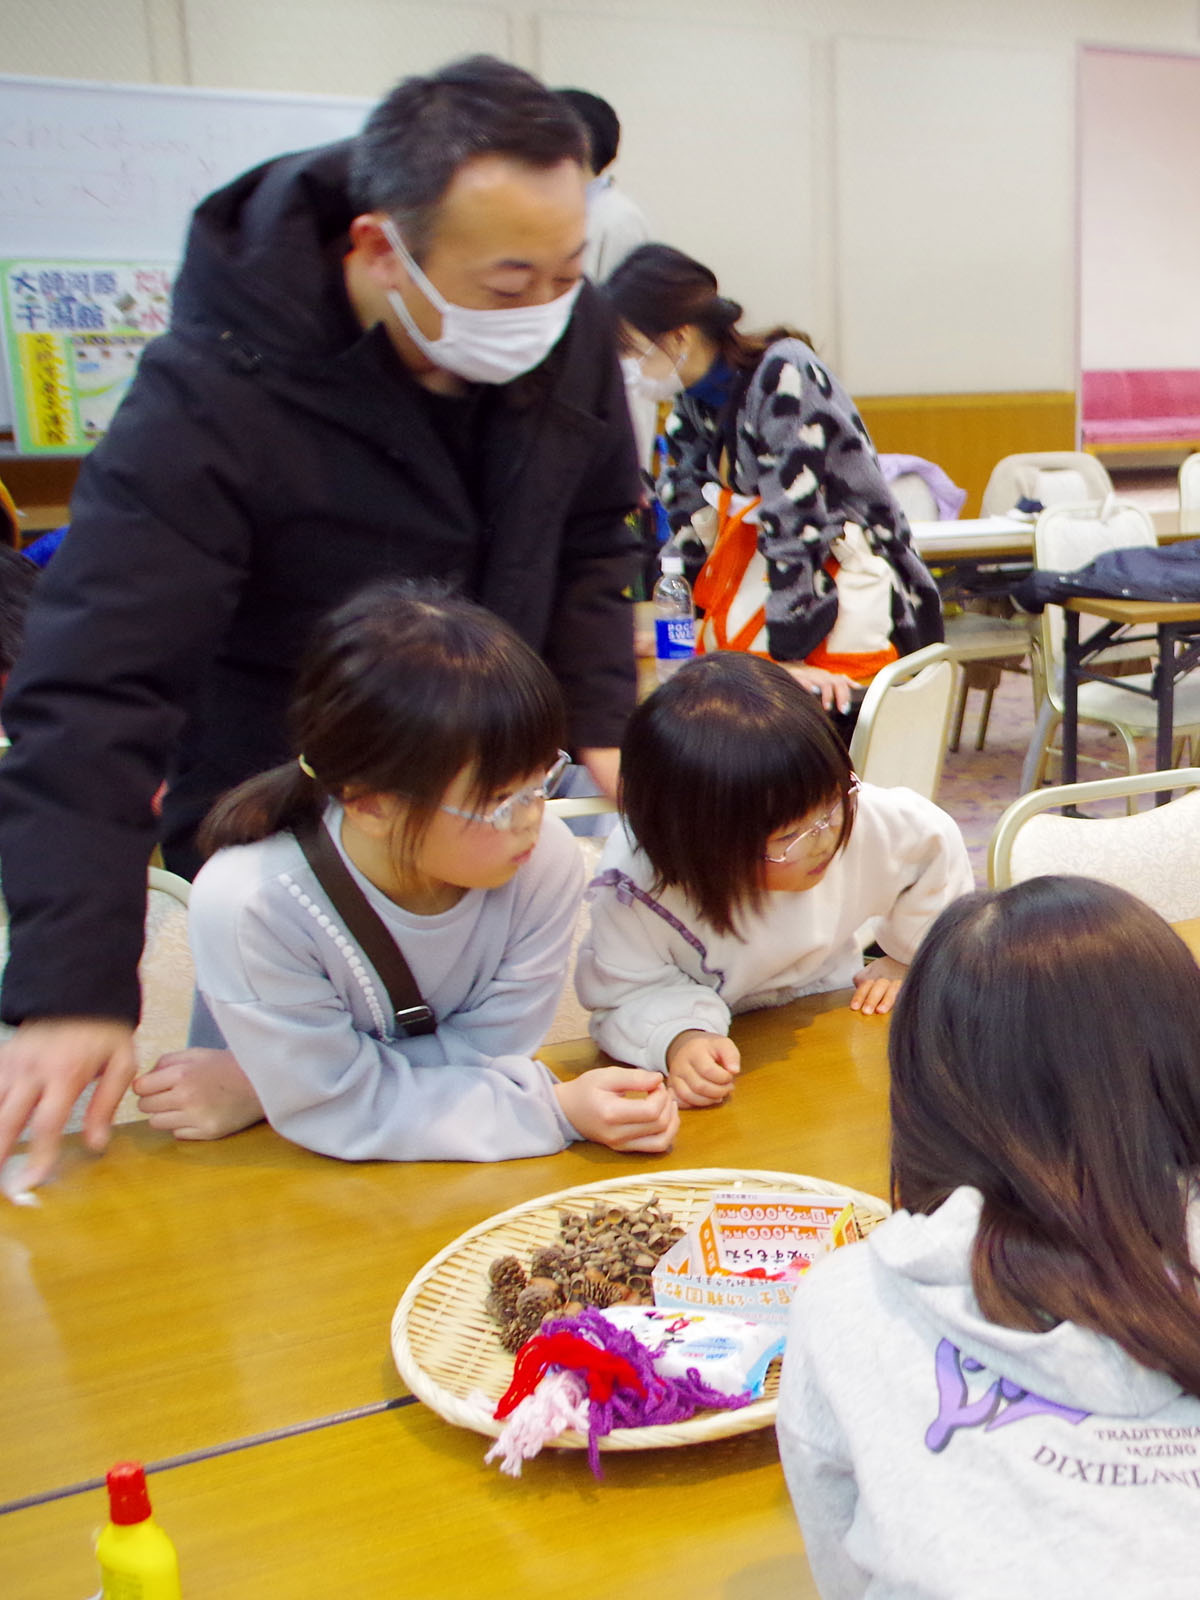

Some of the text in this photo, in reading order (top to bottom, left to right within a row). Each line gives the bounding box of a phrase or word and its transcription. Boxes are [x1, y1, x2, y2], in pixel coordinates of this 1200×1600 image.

[652, 1276, 798, 1307] 育士・幼稚園教
